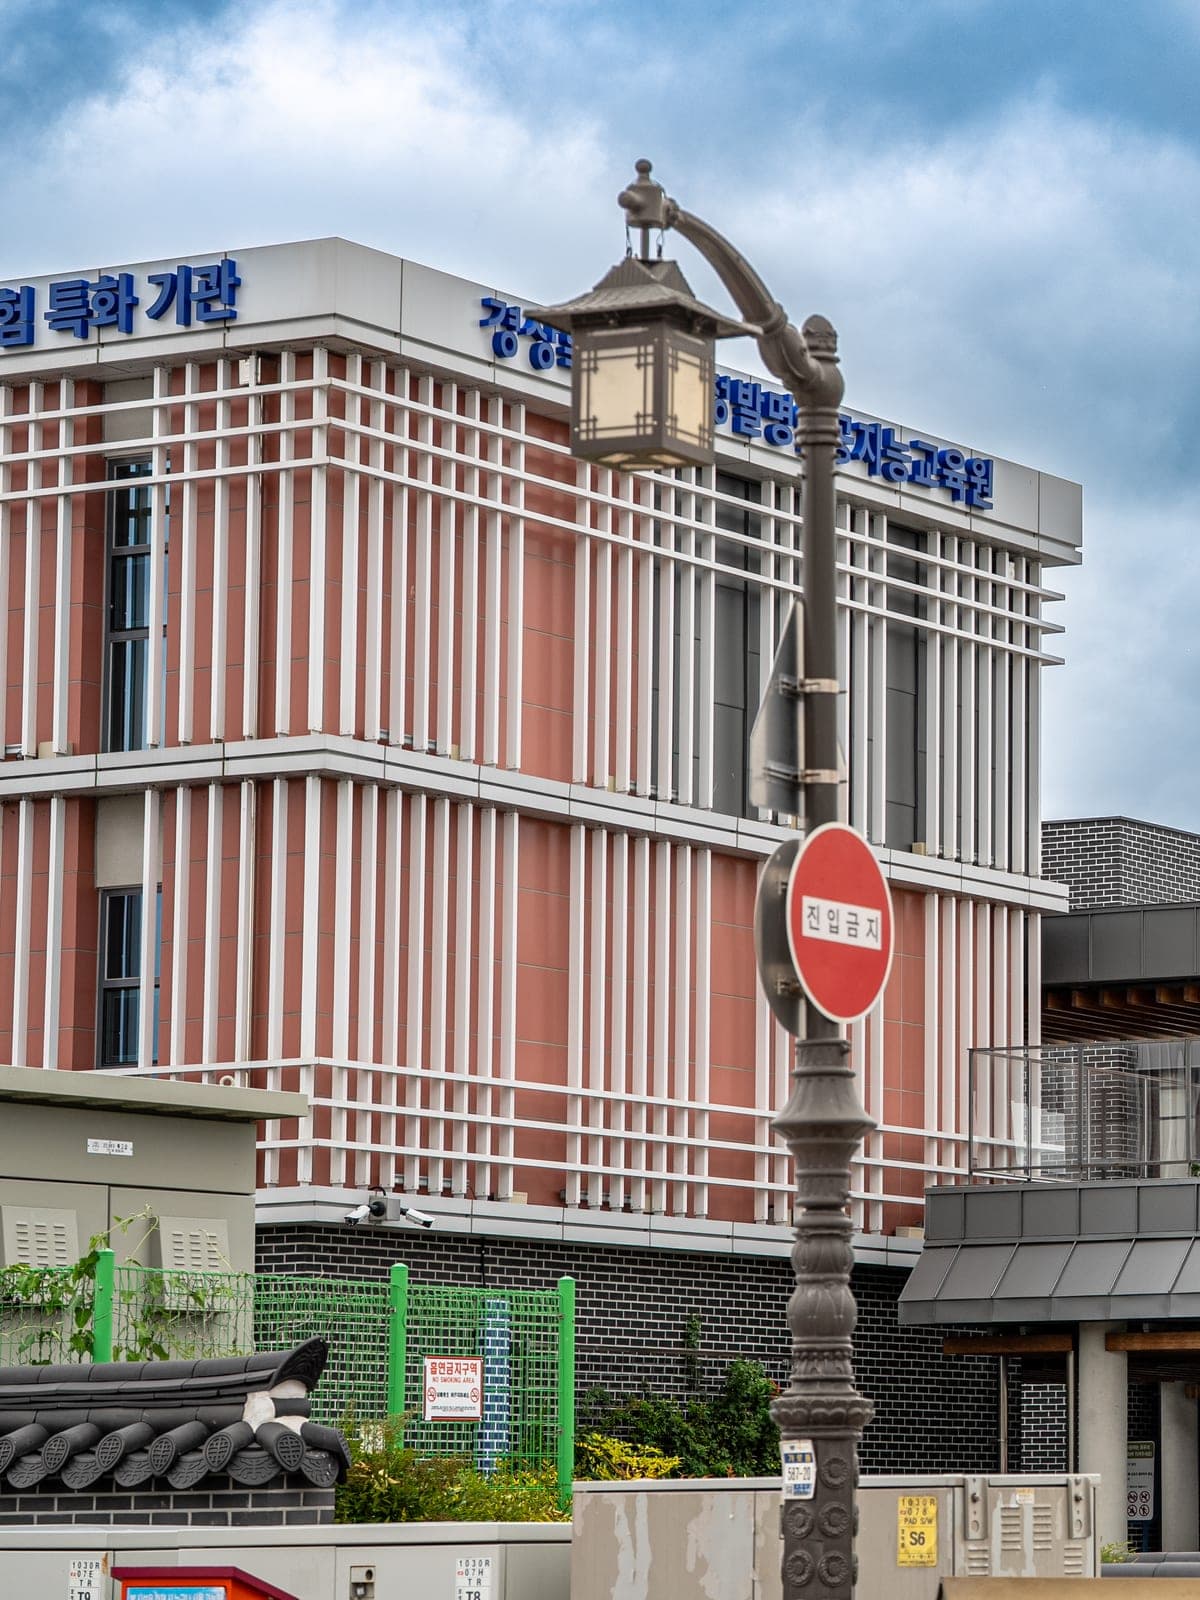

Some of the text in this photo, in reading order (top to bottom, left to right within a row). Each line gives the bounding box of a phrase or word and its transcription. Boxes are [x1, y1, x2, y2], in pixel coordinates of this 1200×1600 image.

[44, 273, 139, 339] 특화
[145, 259, 241, 326] 기관
[806, 904, 880, 943] 진입금지
[430, 1361, 478, 1376] 흡연금지구역
[909, 1531, 926, 1546] S6
